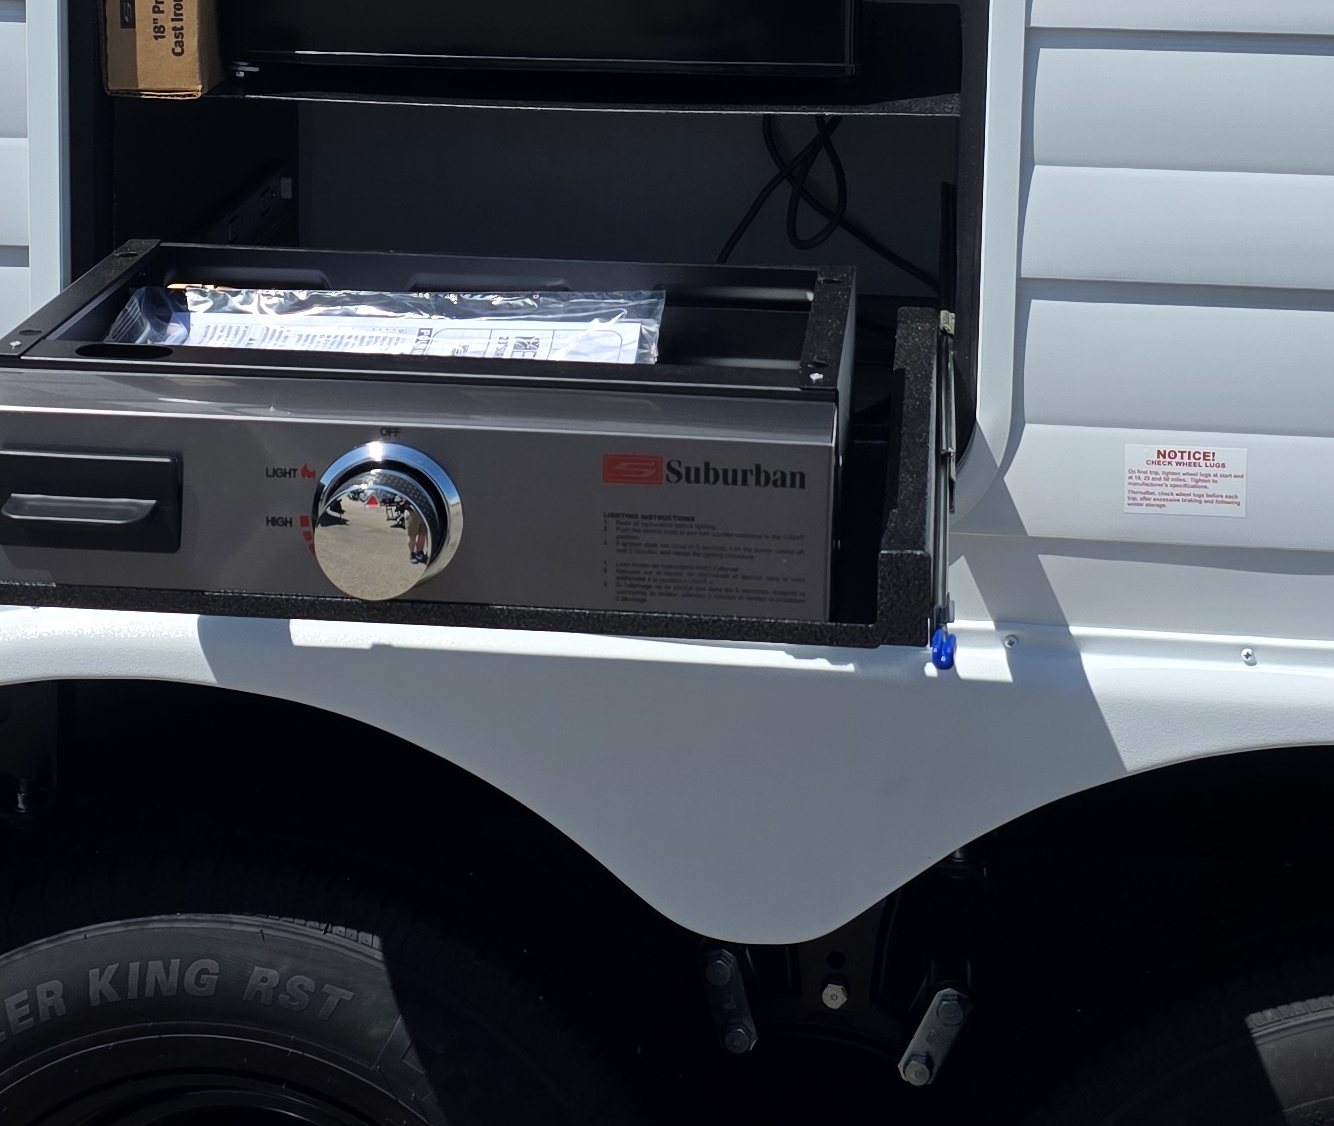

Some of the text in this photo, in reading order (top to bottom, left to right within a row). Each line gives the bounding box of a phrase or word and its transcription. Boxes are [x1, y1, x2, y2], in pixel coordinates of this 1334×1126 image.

[154, 18, 166, 41] 18"
[172, 26, 185, 56] Cast
[380, 427, 401, 437] OFF
[1156, 449, 1216, 461] NOTICE!
[266, 467, 298, 478] LIGHT
[666, 459, 806, 490] Suburban
[266, 516, 292, 527] HIGH
[603, 512, 695, 522] LIGHTING INSTRUCTIONS
[87, 958, 221, 1008] KING
[243, 963, 355, 1023] RST
